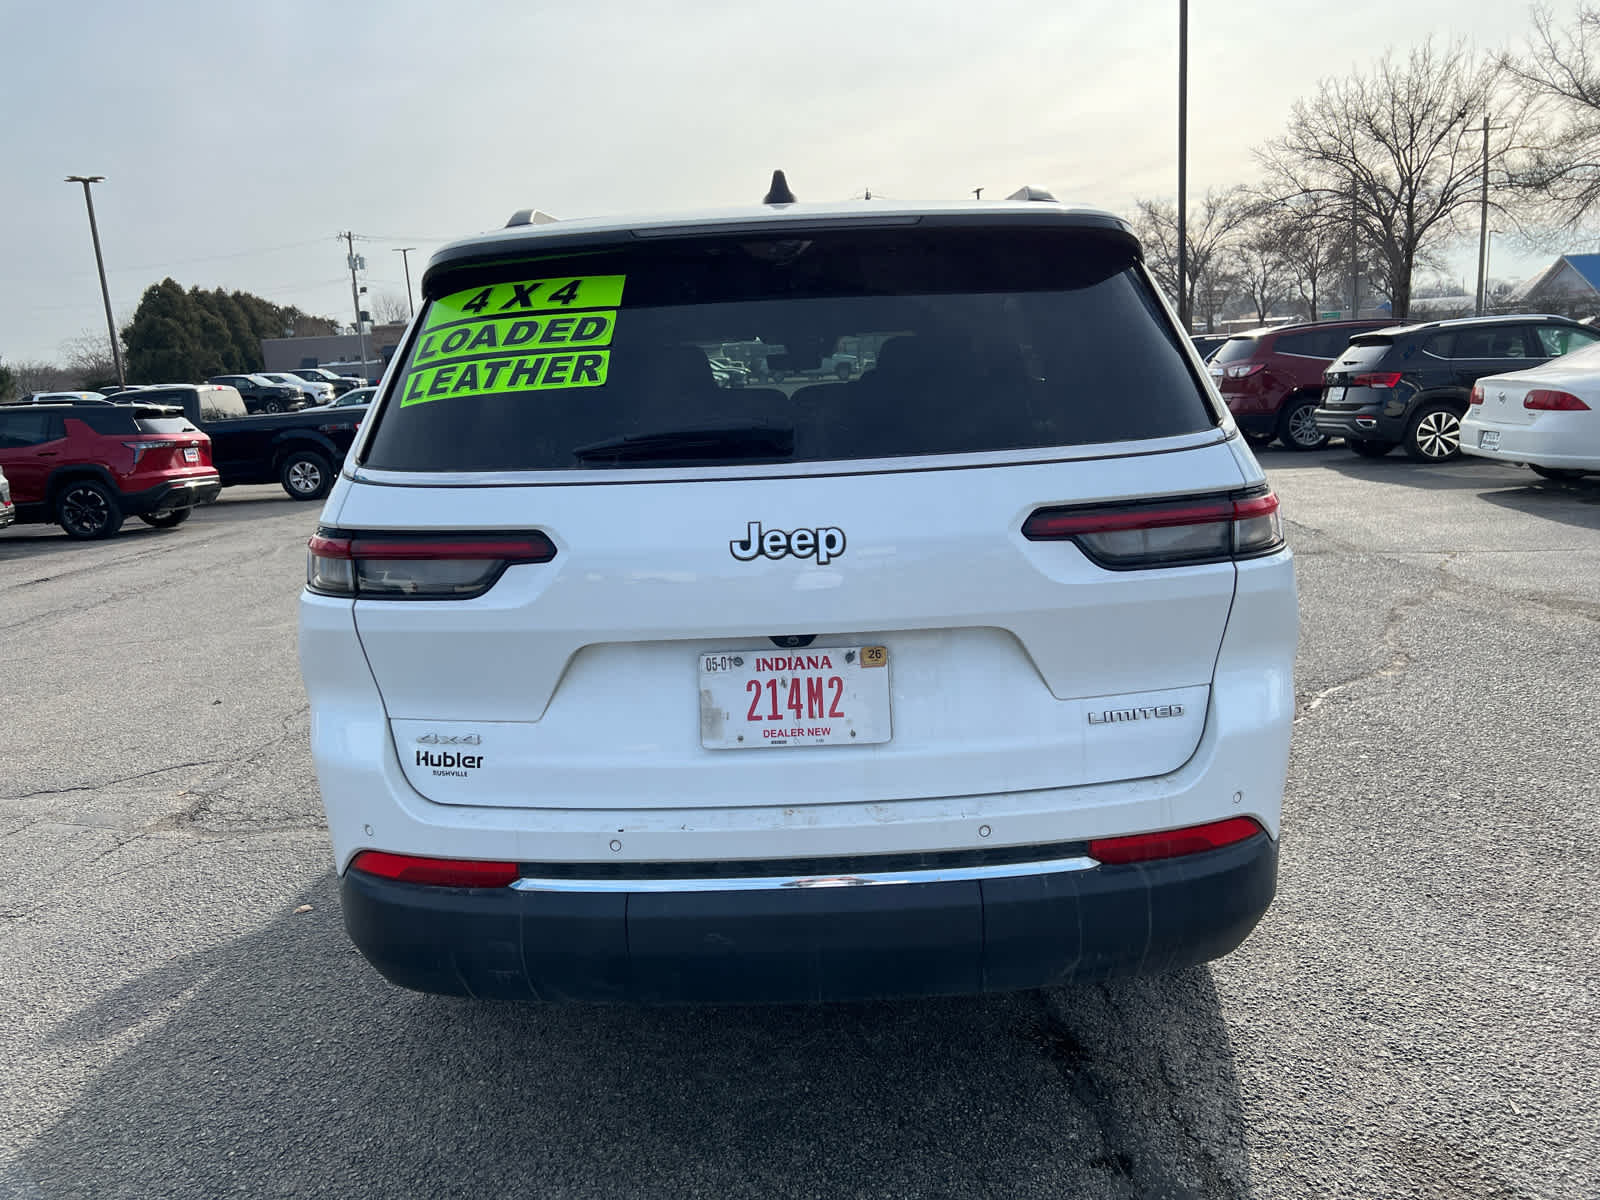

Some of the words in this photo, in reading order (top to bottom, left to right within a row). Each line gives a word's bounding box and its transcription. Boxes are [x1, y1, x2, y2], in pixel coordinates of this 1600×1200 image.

[417, 316, 611, 360] LOADED
[405, 355, 606, 401] LEATHER
[730, 521, 846, 565] Jeep
[756, 655, 832, 672] INDIANA
[868, 649, 881, 659] 26
[746, 676, 845, 721] 214M2
[1088, 704, 1184, 725] LIMITED
[763, 728, 804, 738] DEALER
[807, 727, 831, 736] NEW
[416, 751, 484, 768] Hubler
